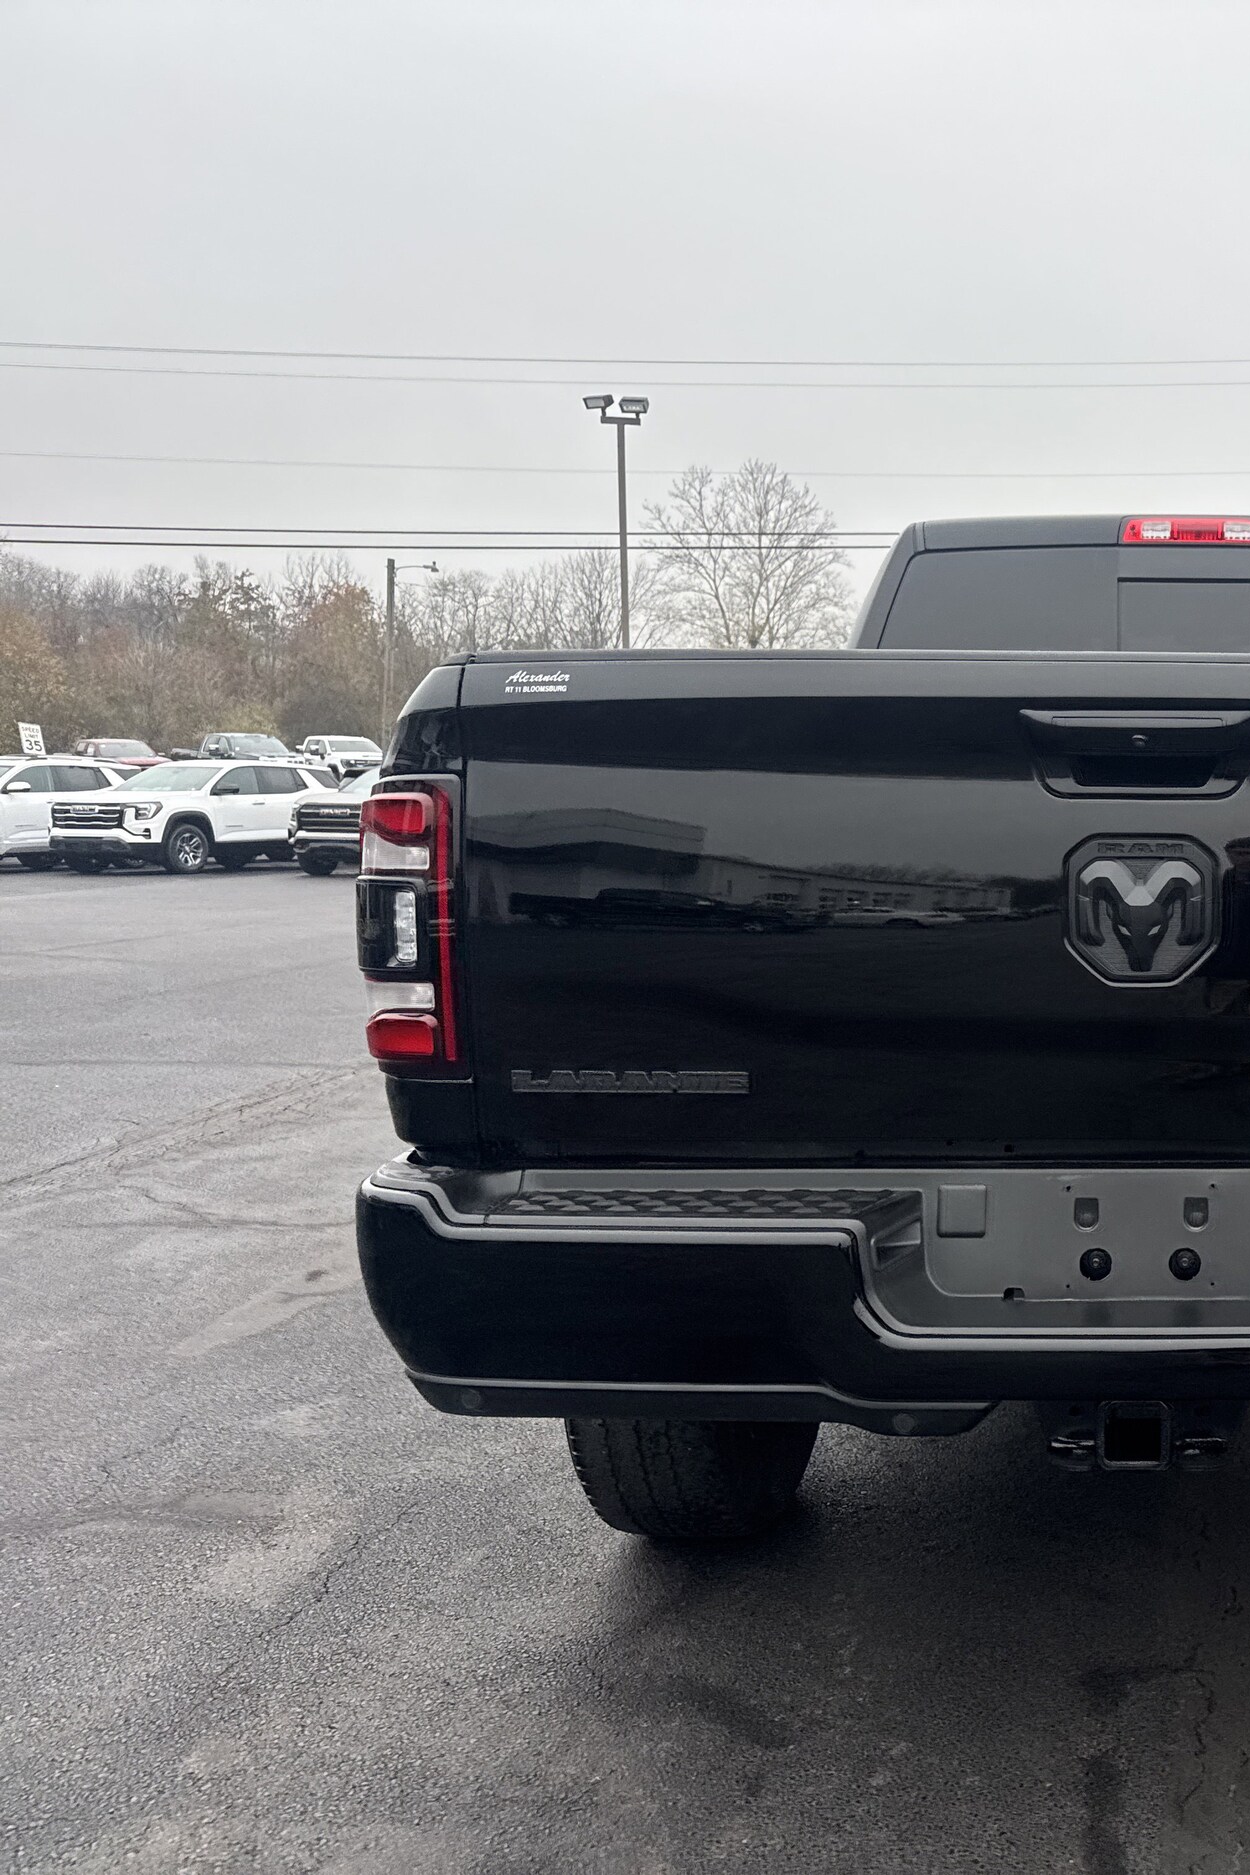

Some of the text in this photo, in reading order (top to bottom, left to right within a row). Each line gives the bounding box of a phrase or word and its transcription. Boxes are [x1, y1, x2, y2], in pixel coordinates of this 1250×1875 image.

[505, 670, 570, 683] Alexander
[523, 685, 567, 693] BLOOMSBURG
[25, 739, 43, 752] 35
[1097, 842, 1184, 854] RAM
[511, 1069, 750, 1094] LARAMIE
